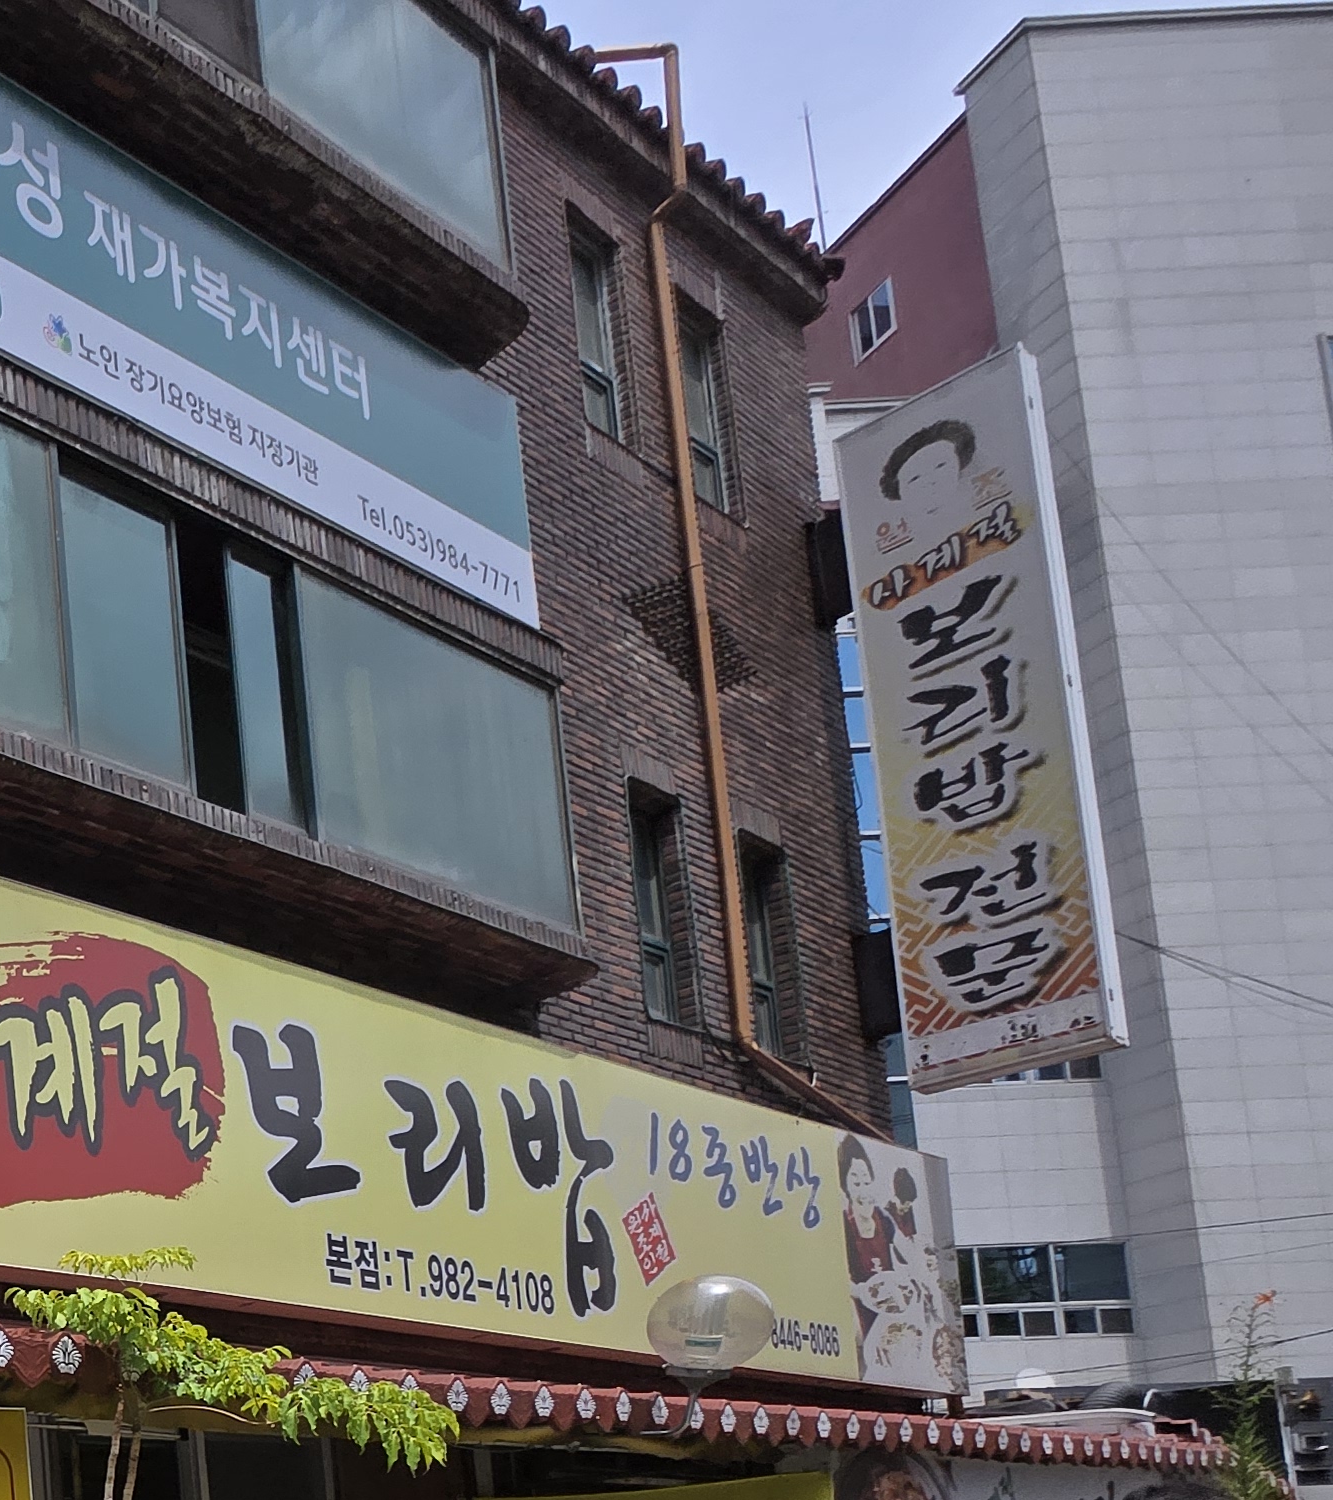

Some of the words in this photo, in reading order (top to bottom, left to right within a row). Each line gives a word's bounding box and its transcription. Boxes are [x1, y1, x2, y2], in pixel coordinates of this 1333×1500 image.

[84, 190, 371, 420] 재가복지센터
[248, 424, 320, 487] 지정기관
[357, 494, 522, 603] Tel.053)984-7771
[896, 574, 1033, 826] 보리밥
[232, 1024, 617, 1316] 보리밥
